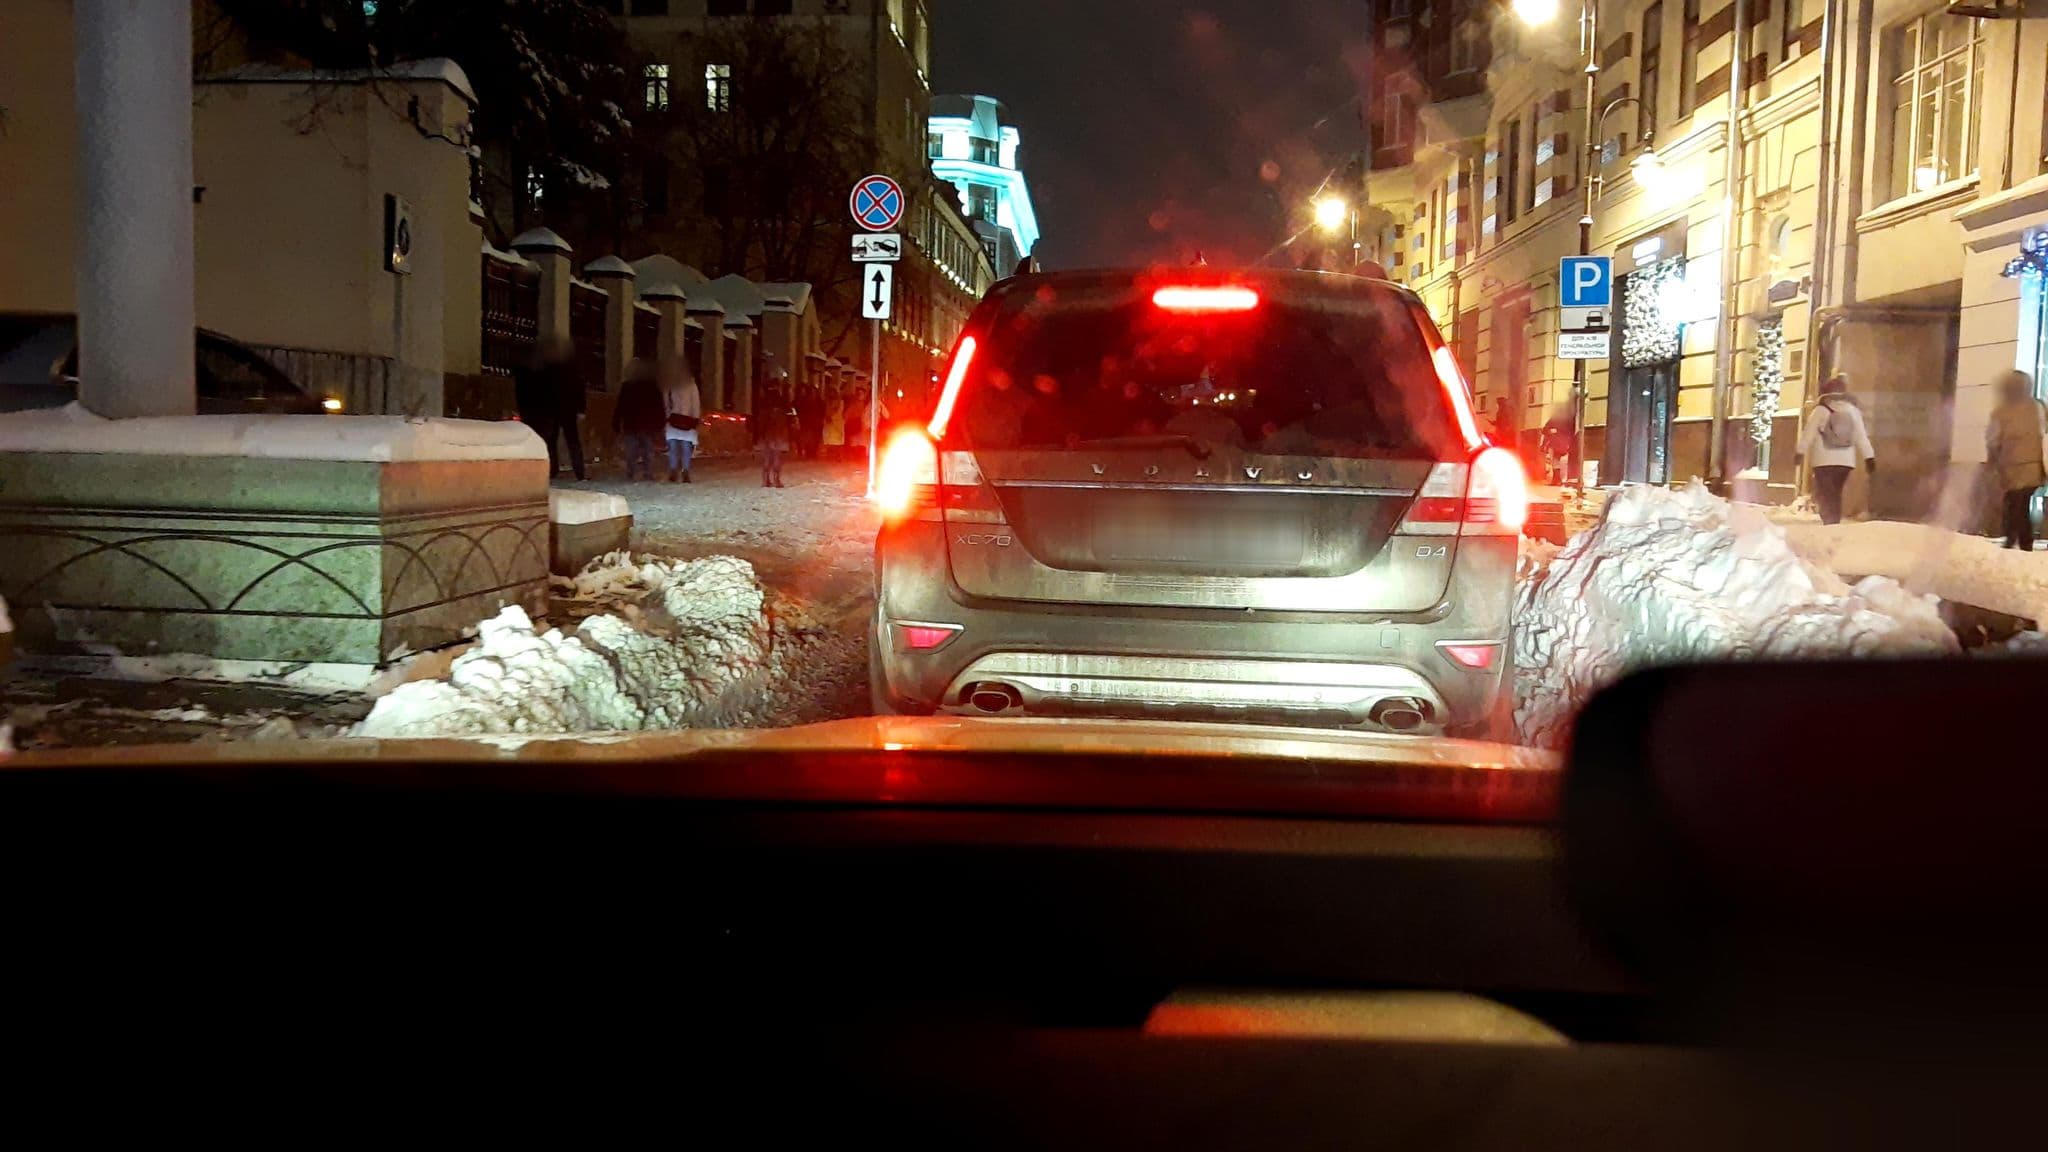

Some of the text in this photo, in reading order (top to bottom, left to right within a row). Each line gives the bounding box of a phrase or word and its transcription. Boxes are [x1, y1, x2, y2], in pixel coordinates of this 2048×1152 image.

[1574, 261, 1602, 301] P
[1091, 463, 1313, 480] VOLVO
[955, 534, 1012, 546] XC70
[1415, 545, 1446, 557] D4
